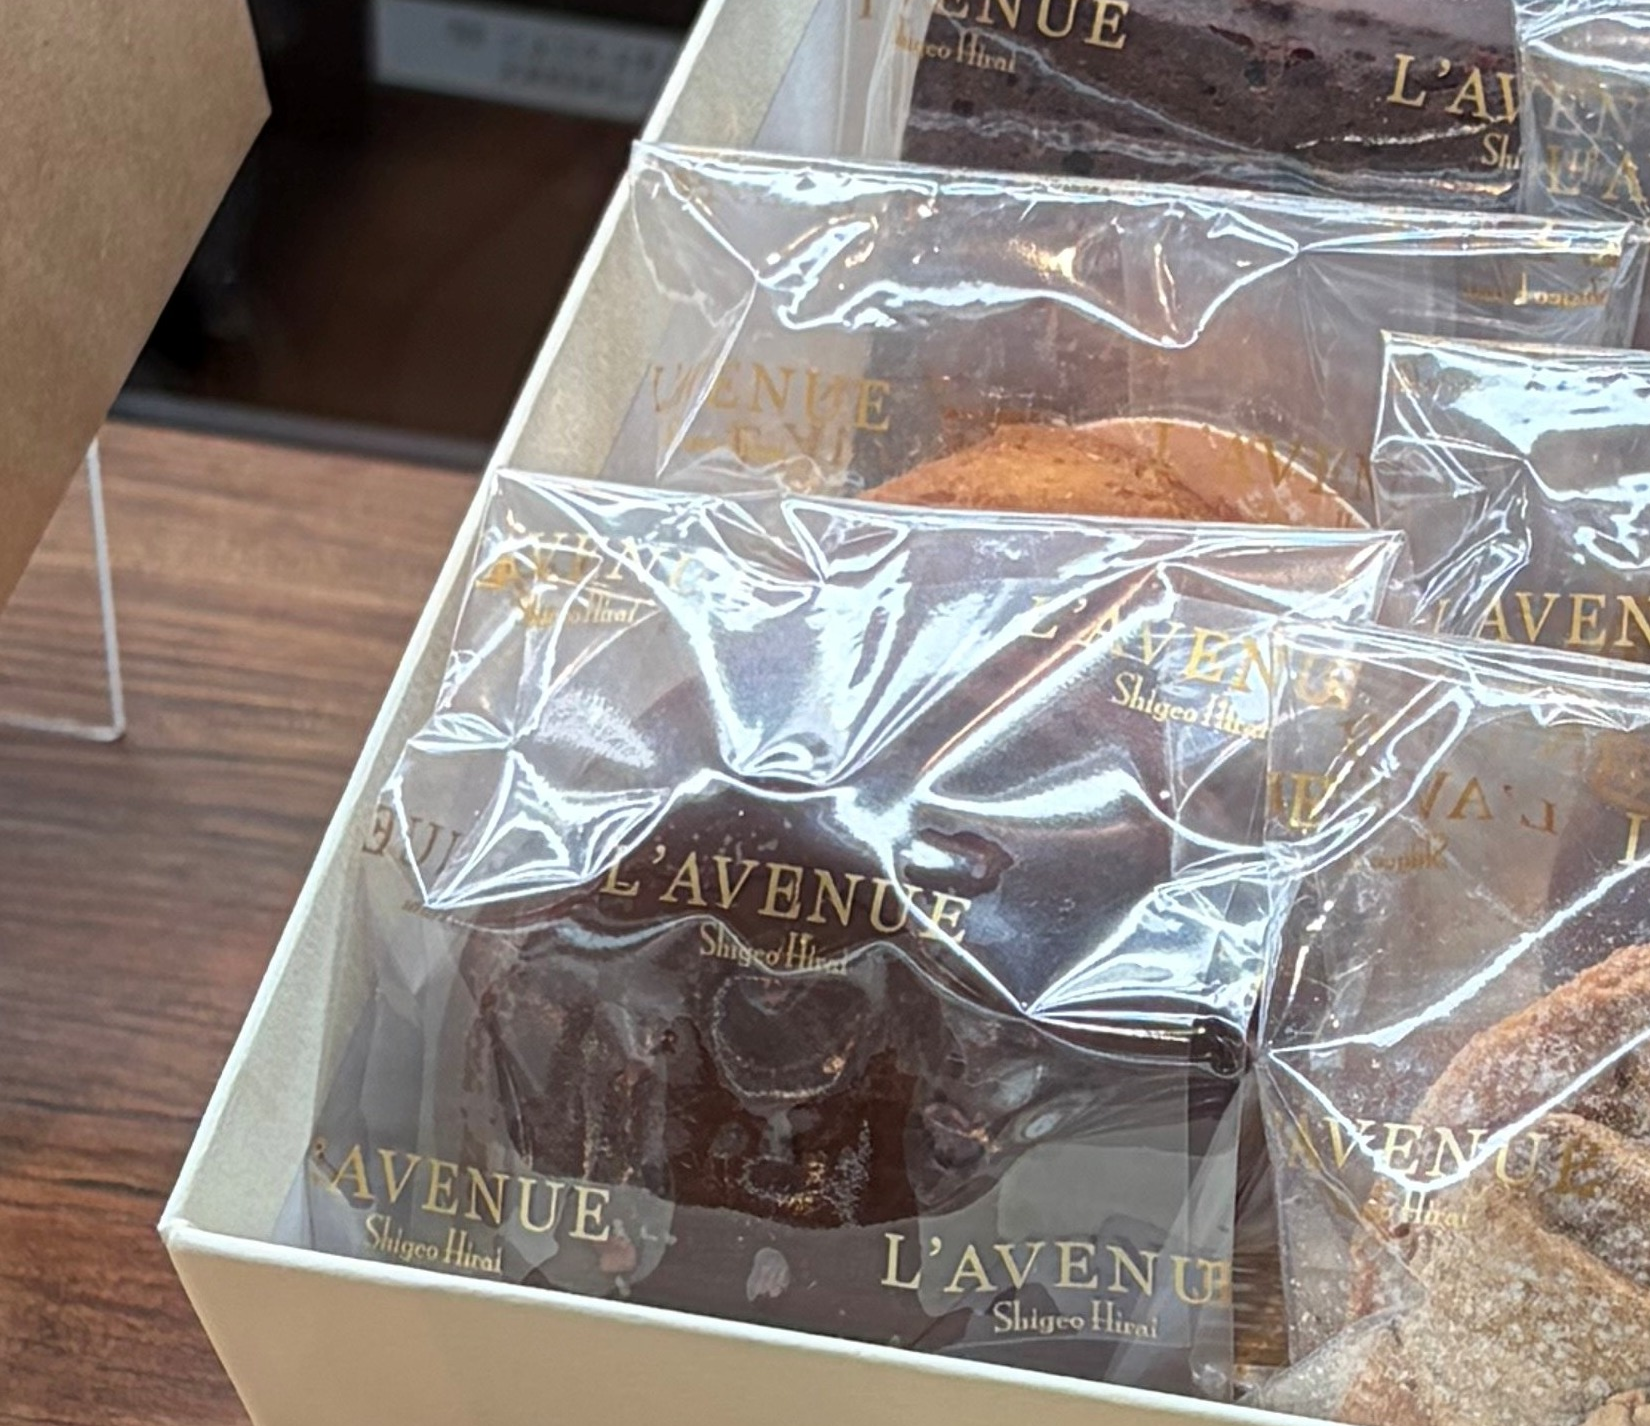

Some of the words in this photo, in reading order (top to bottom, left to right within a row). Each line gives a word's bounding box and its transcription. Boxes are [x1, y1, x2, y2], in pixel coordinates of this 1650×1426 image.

[1111, 671, 1198, 724] Shigeo
[600, 844, 972, 944] L'AVENUE
[699, 922, 780, 968] Shigeo
[364, 1213, 438, 1262] Shigeo
[443, 1227, 501, 1274] Hirai
[993, 1299, 1085, 1336] Shigeo
[1091, 1299, 1158, 1339] Hirai
